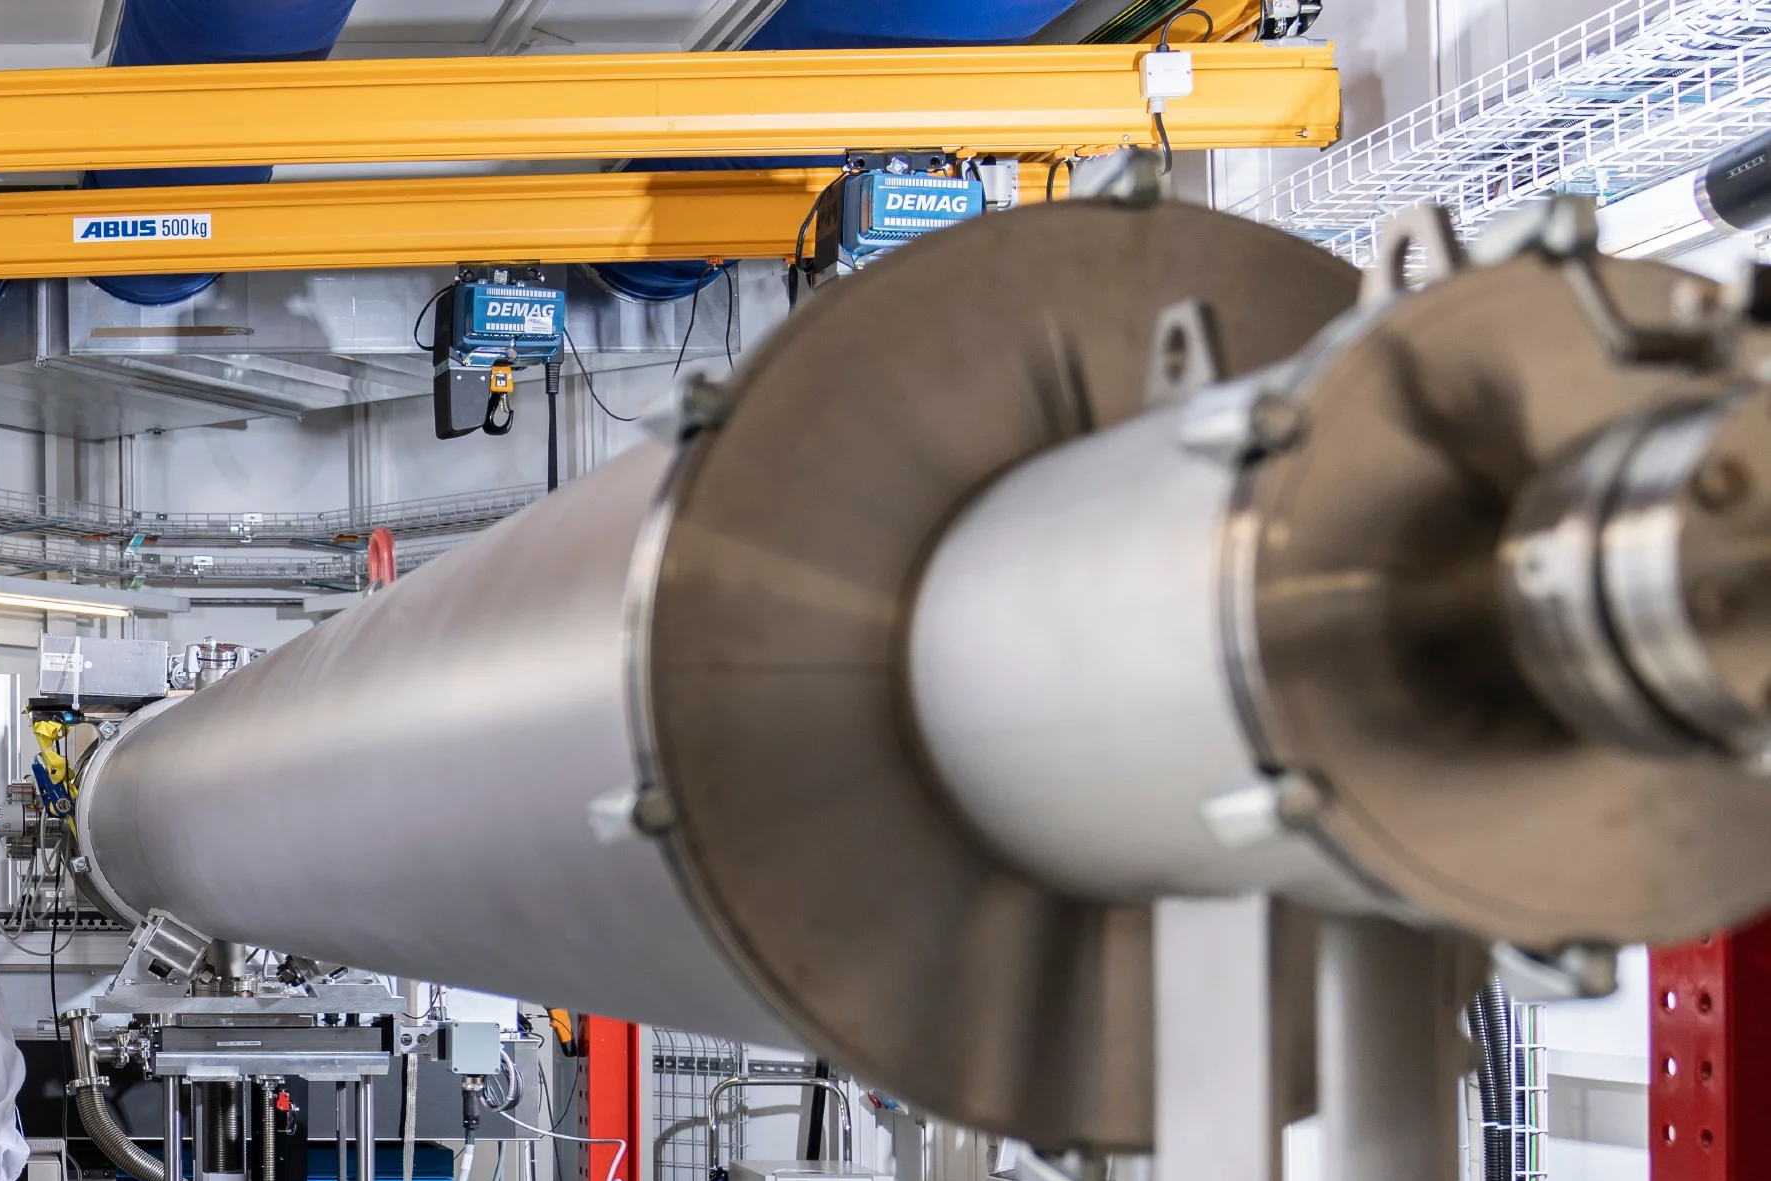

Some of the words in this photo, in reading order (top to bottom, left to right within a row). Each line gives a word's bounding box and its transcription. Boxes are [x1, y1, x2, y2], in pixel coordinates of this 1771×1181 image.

[885, 193, 968, 213] DEMAG
[80, 220, 157, 239] ABUS
[486, 301, 555, 318] DEMAG
